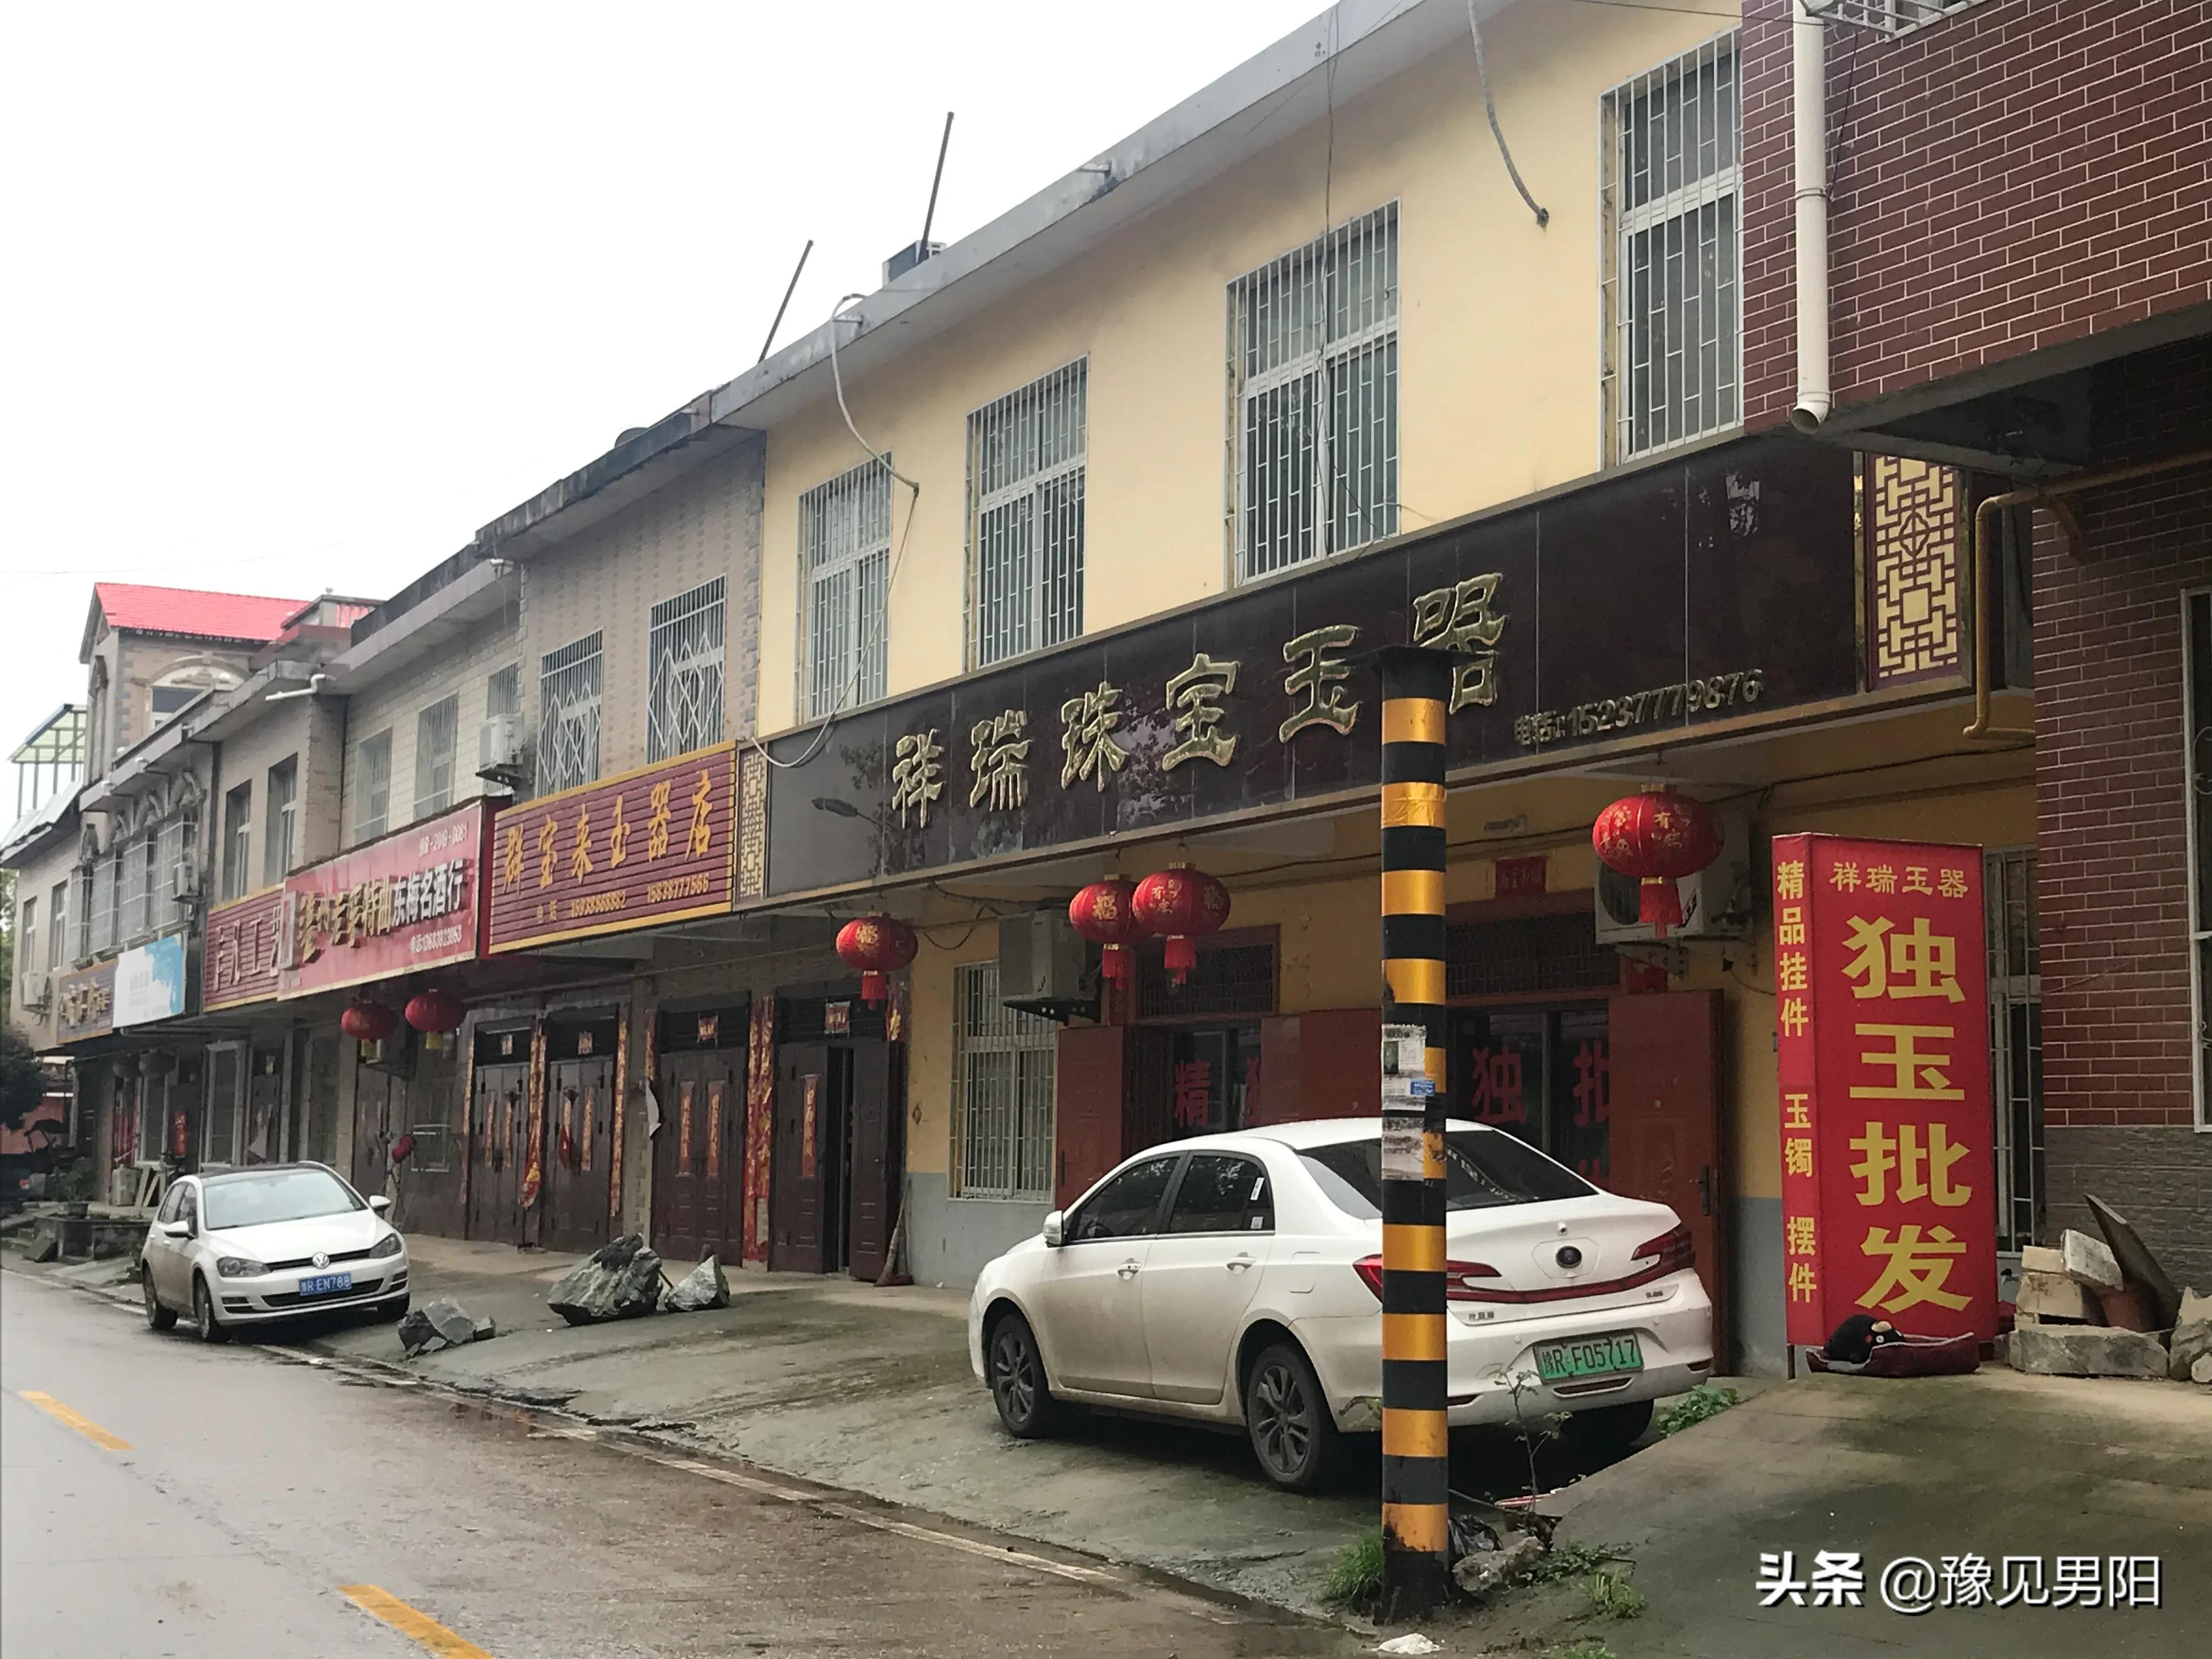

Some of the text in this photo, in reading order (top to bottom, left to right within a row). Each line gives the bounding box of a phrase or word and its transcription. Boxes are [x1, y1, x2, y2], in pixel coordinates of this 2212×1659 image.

[1829, 861, 1969, 900] 祥瑞玉器
[1777, 860, 1818, 1304] 精品挂件 玉镯 摆件
[1841, 915, 1973, 1314] 独玉批发
